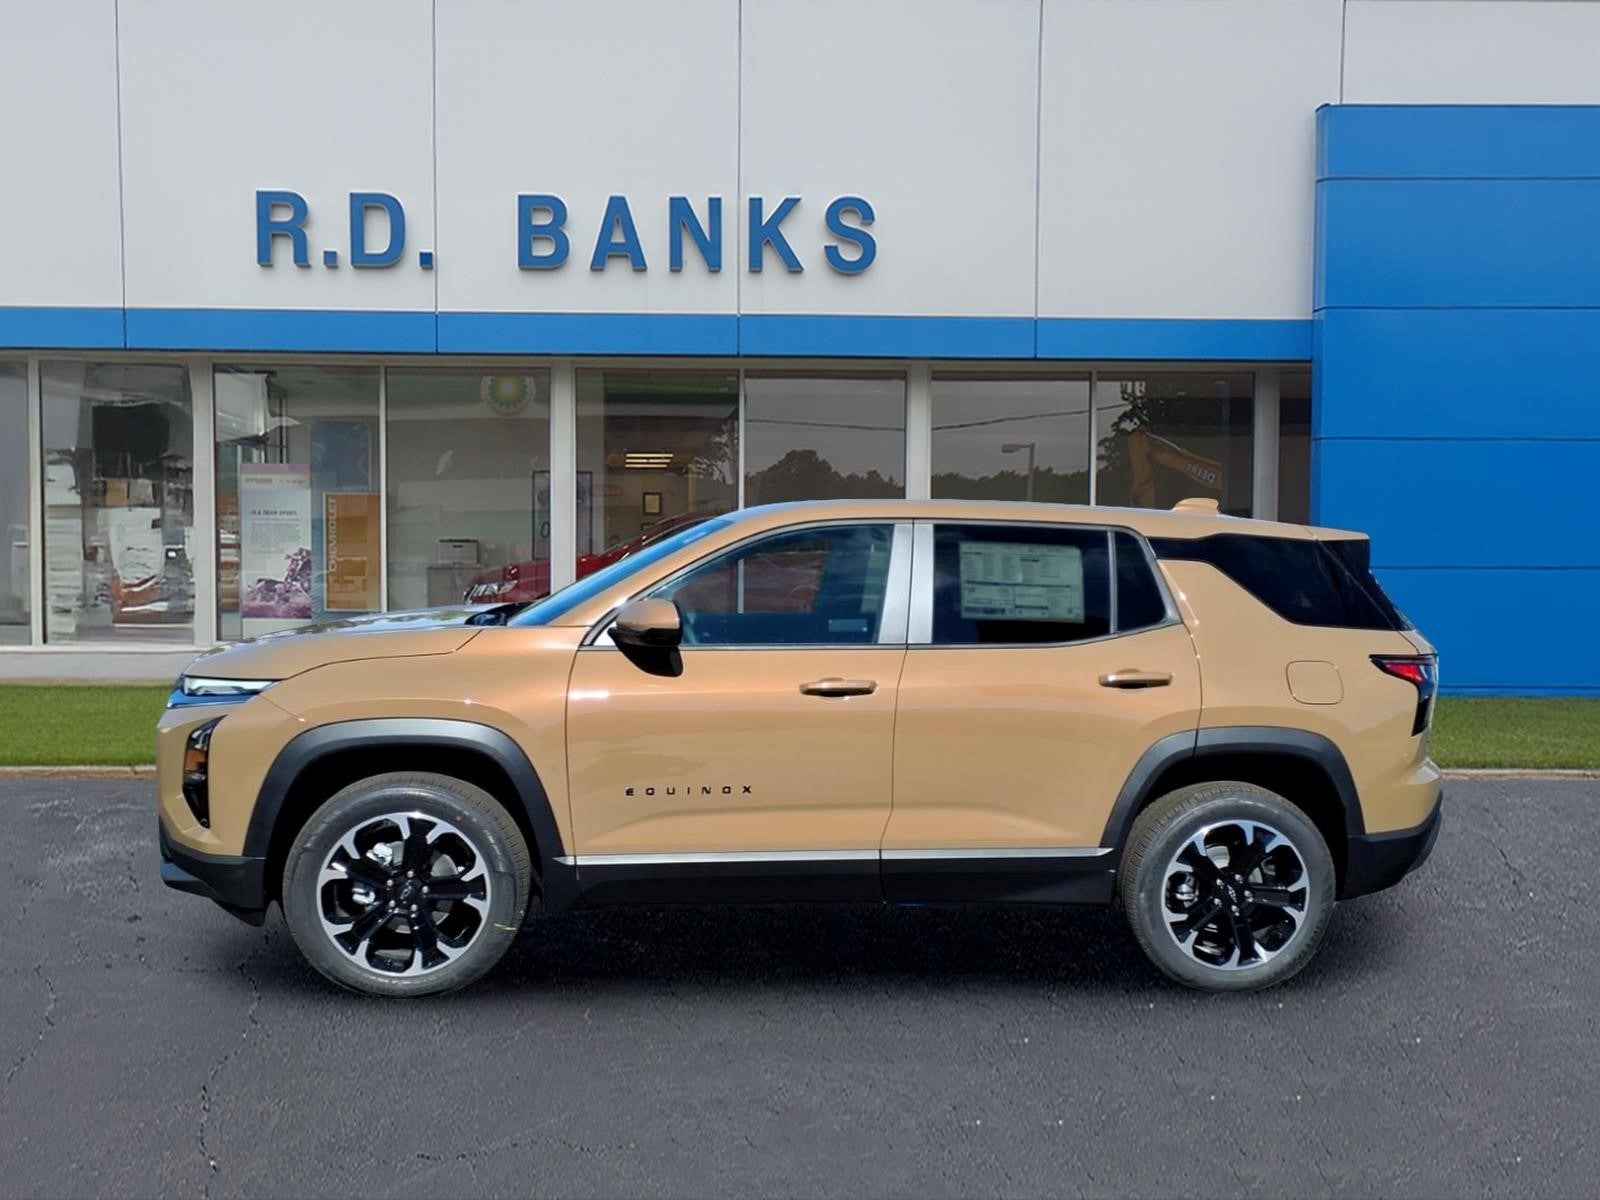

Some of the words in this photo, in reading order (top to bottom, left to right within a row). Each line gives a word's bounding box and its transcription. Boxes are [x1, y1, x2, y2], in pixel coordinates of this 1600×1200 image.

[257, 190, 434, 270] R.D.
[518, 193, 877, 275] BANKS
[625, 785, 752, 796] EQUINOX
